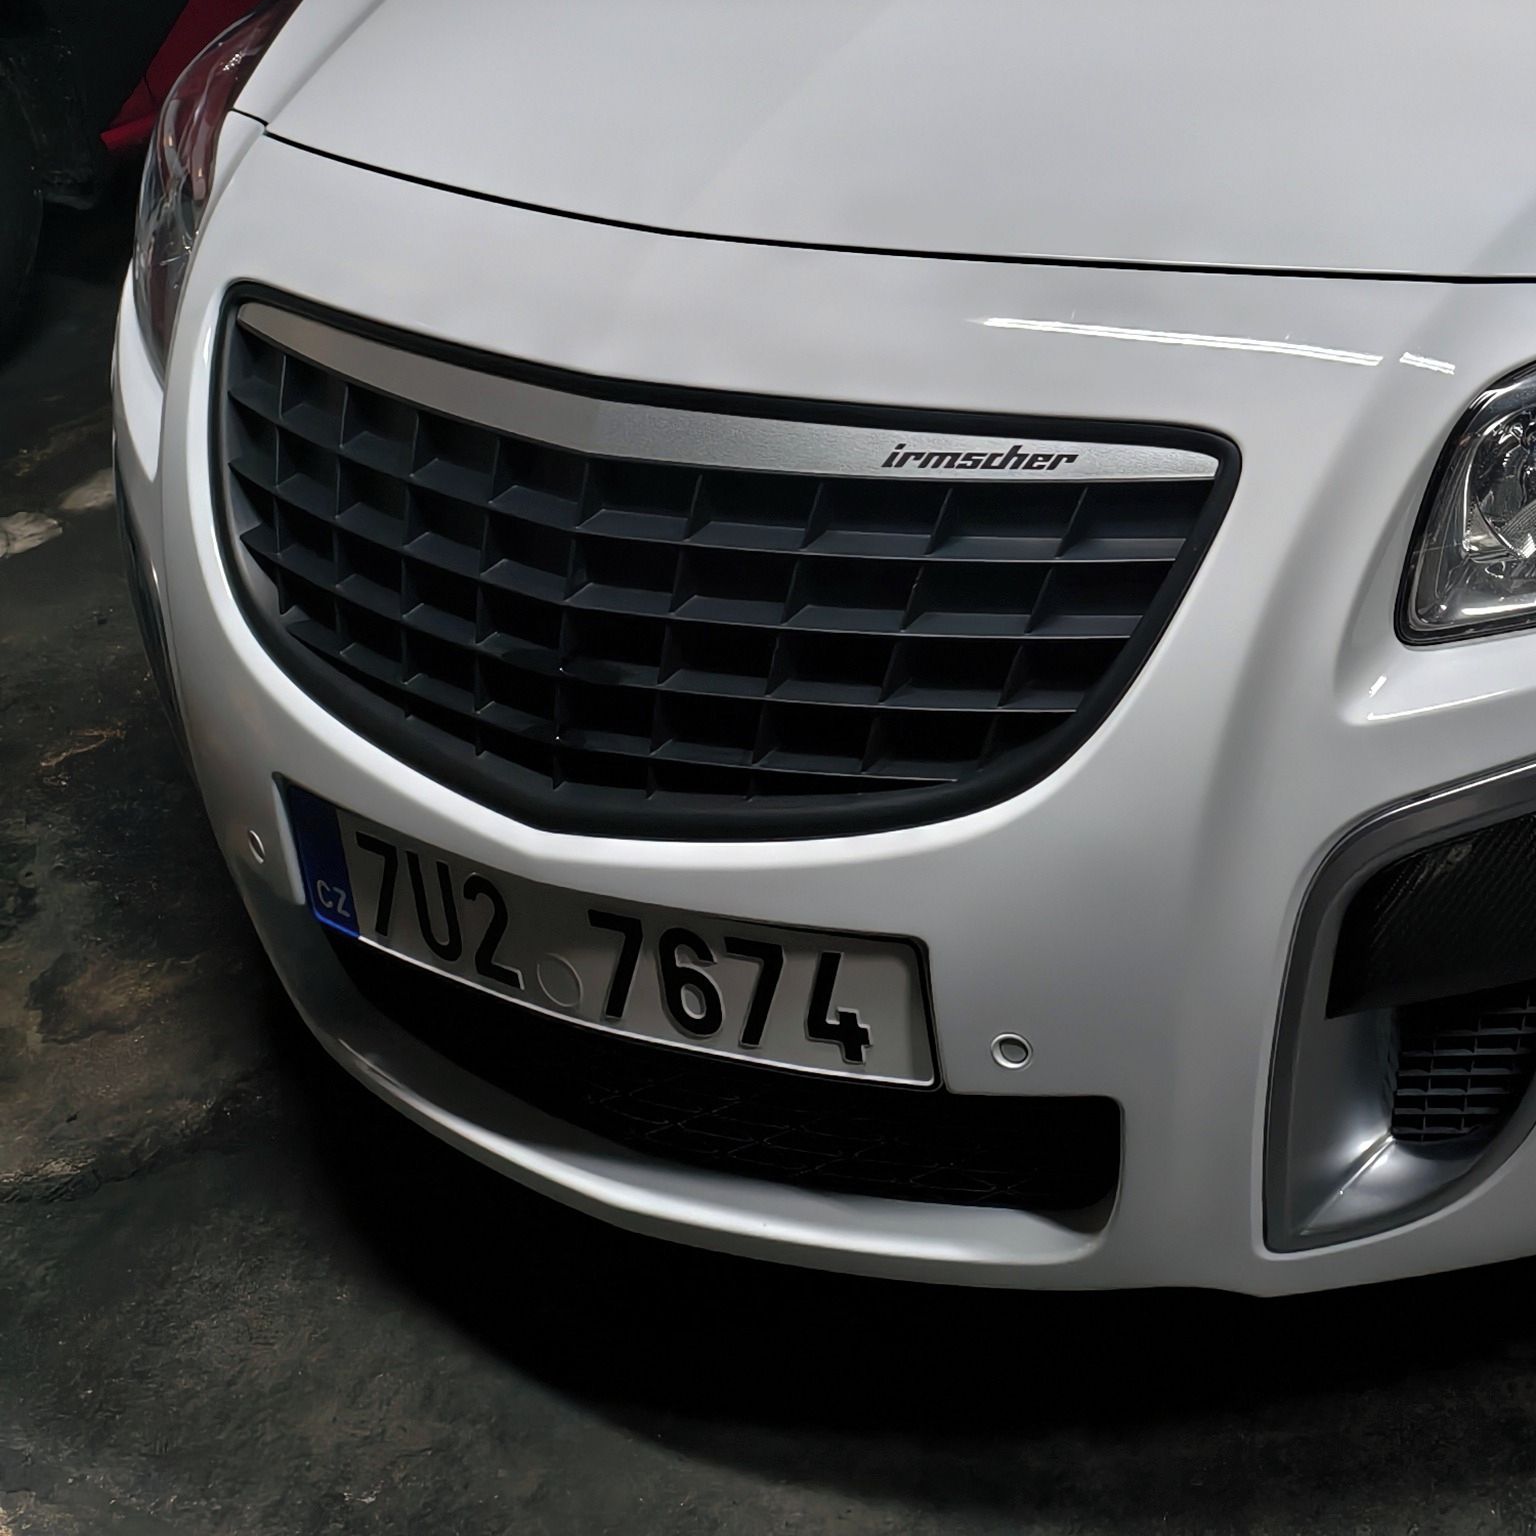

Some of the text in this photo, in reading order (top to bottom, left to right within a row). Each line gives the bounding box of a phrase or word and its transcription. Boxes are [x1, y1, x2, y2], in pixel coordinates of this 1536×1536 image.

[880, 443, 1079, 471] irmscher
[316, 879, 351, 918] CZ
[356, 831, 871, 1063] 7U2 7674
